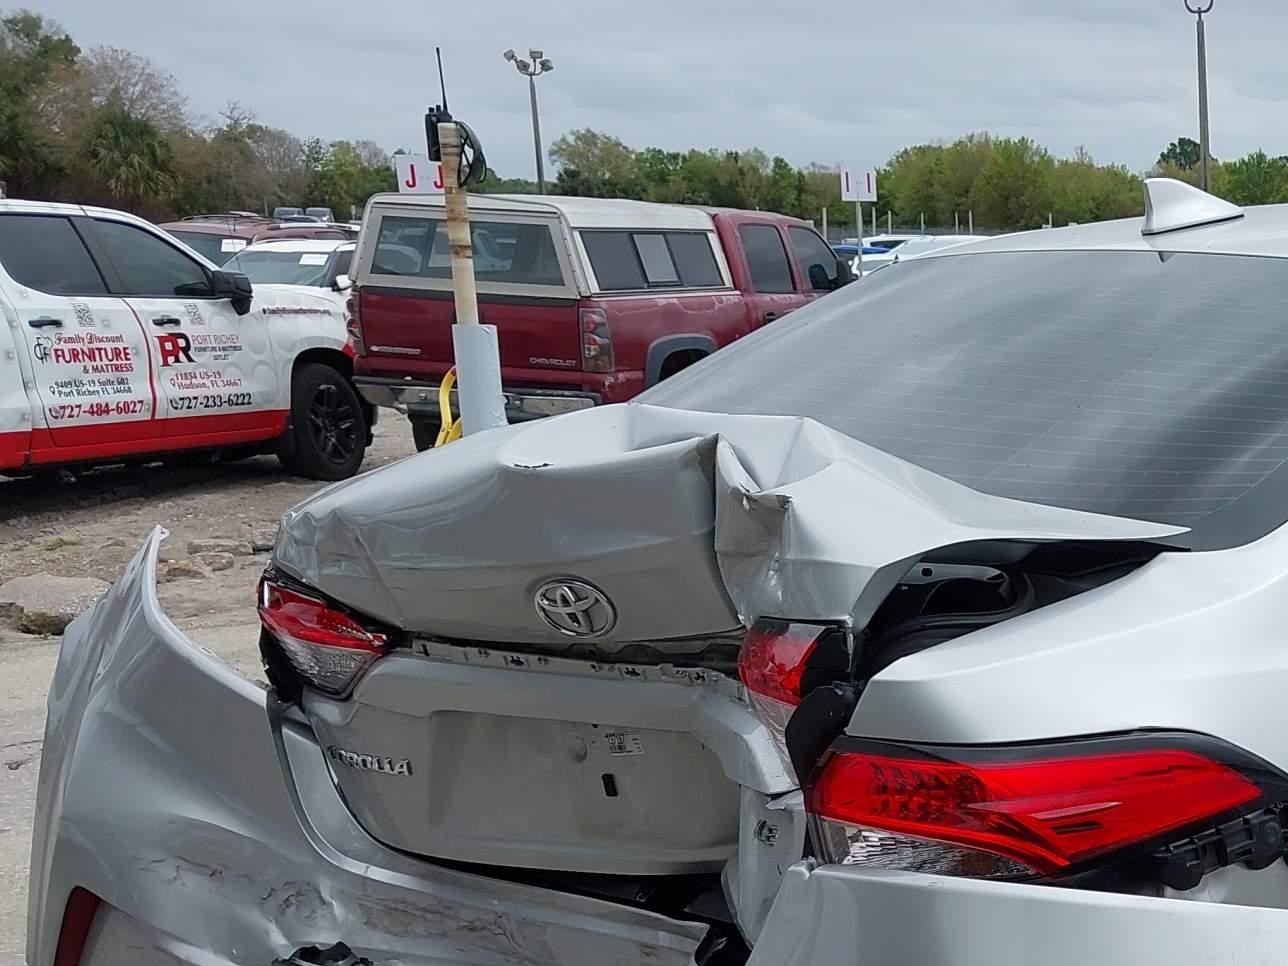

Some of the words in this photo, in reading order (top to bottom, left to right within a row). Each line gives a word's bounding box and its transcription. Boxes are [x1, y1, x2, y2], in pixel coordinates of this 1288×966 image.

[405, 163, 416, 188] J
[54, 332, 85, 346] Family
[86, 332, 124, 344] Discount
[191, 334, 212, 345] PORT
[213, 334, 240, 345] RICHEY
[53, 346, 131, 363] FURNITURE
[82, 365, 90, 374] &
[92, 362, 134, 373] MATTRESS
[199, 370, 221, 380] US-19
[74, 379, 96, 388] US-19
[97, 377, 115, 387] Suite
[176, 380, 210, 390] Hudson,
[211, 379, 220, 388] FL
[58, 390, 75, 398] Port
[77, 387, 101, 398] Richey
[102, 387, 110, 395] FL
[179, 392, 252, 410] 727-233-6222
[59, 400, 144, 419] 727-484-6027
